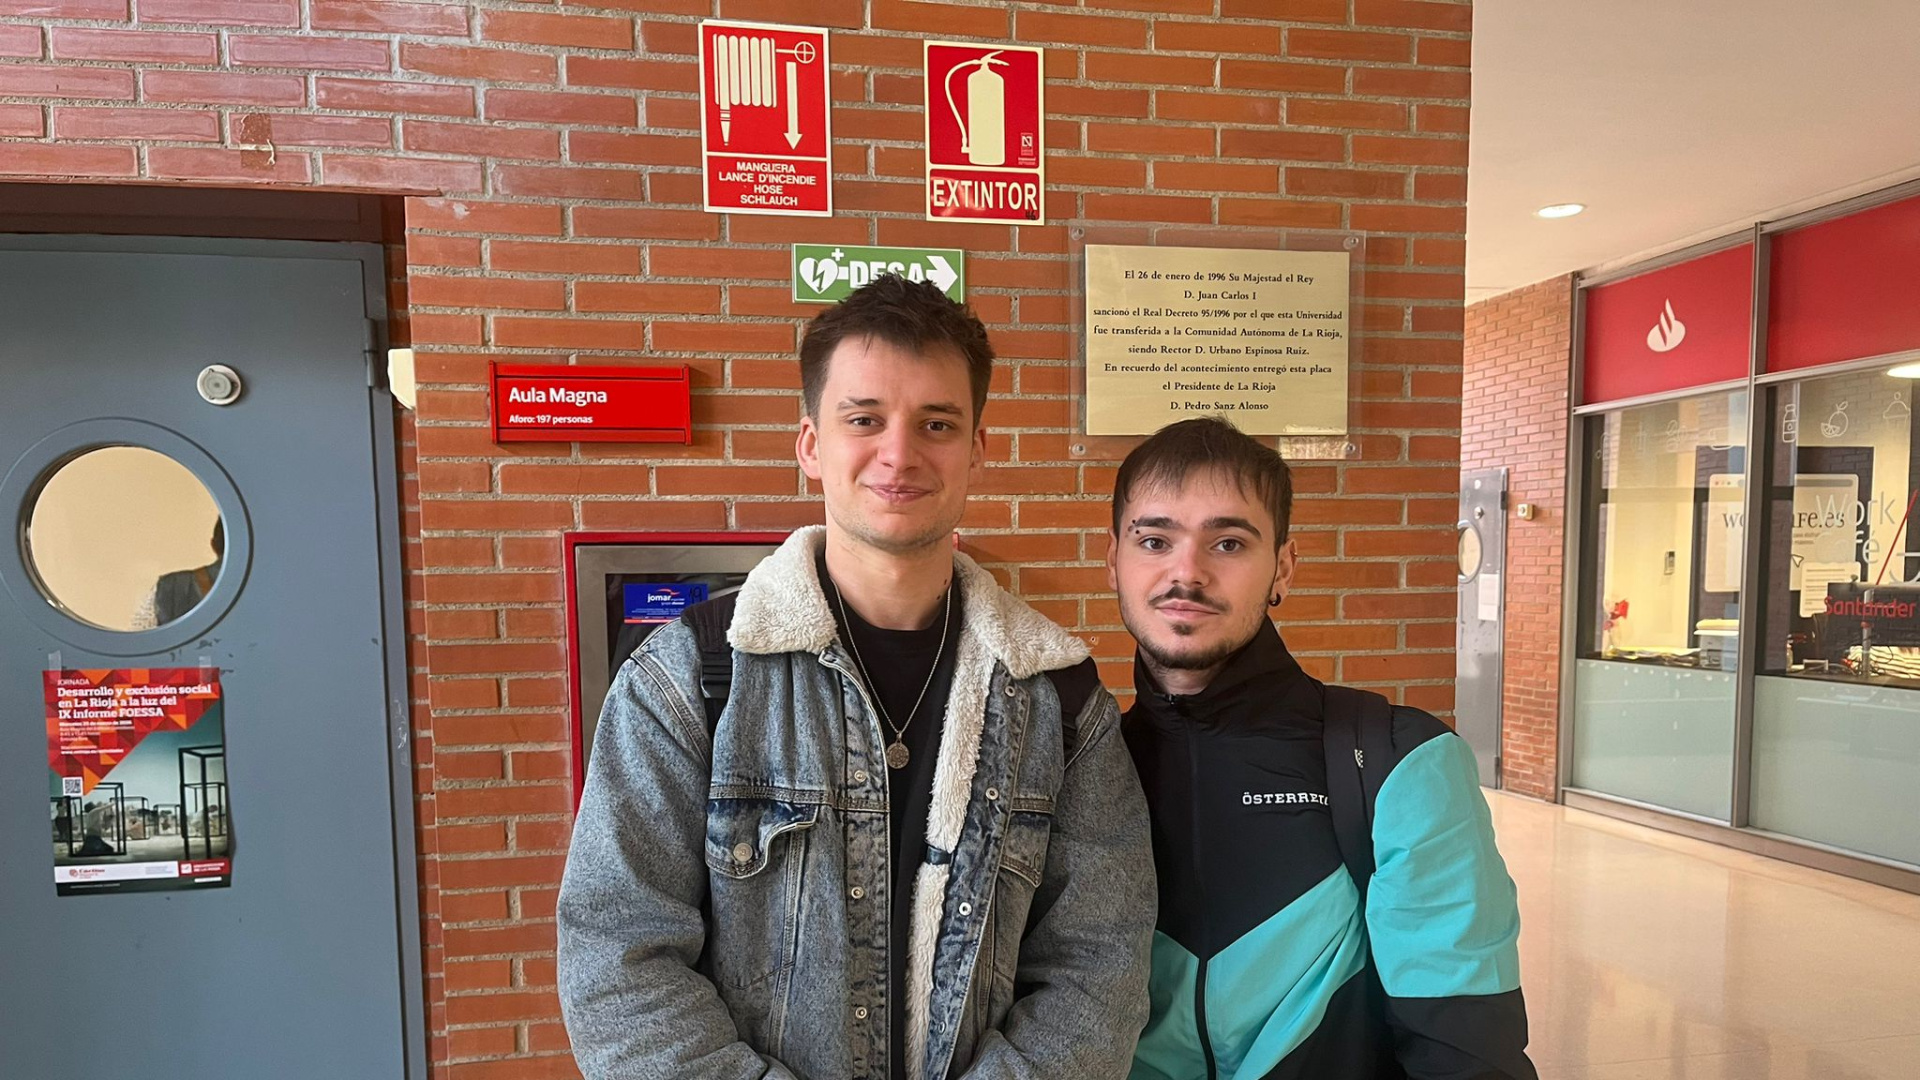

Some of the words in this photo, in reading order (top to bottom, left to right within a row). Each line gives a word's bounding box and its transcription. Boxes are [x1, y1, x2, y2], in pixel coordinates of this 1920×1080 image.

[736, 161, 796, 174] MANGUERA
[719, 172, 754, 182] LANCE
[758, 174, 816, 186] D'INCENDIE
[754, 184, 783, 194] HOSE
[933, 179, 1037, 210] EXTINTOR
[740, 194, 798, 206] SCHLAUCH
[1125, 270, 1135, 279] El
[1138, 271, 1148, 279] 26
[1151, 271, 1161, 280] de
[1194, 272, 1204, 281] de
[1208, 273, 1225, 281] 1996
[1229, 273, 1240, 282] Su
[1243, 274, 1282, 284] Majestad
[1286, 274, 1293, 282] el
[1296, 275, 1314, 285] Rey
[1184, 291, 1195, 299] D.
[1197, 291, 1218, 301] Juan
[1221, 291, 1249, 300] Carlos
[1252, 292, 1256, 300] I
[1093, 308, 1129, 316] sancionó
[1133, 308, 1140, 316] el
[1143, 308, 1162, 317] Real
[1165, 309, 1198, 317] Decreto
[1201, 309, 1230, 318] 95/1996
[1233, 311, 1247, 320] por
[1250, 310, 1258, 319] el
[1261, 312, 1275, 321] que
[1296, 310, 1342, 320] Universidad
[1094, 325, 1108, 335] fue
[1112, 326, 1161, 335] transferida
[1173, 327, 1181, 336] la
[1185, 327, 1237, 336] Comunidad
[1240, 328, 1285, 337] Autónoma
[1289, 328, 1299, 337] de
[1302, 329, 1313, 337] La
[1317, 329, 1343, 340] Rioja,
[1128, 345, 1157, 354] siendo
[1160, 345, 1191, 354] Rector
[1195, 346, 1206, 354] D.
[1209, 346, 1241, 355] Urbano
[1245, 346, 1282, 356] Espinosa
[1286, 347, 1309, 355] Ruiz.
[1121, 363, 1160, 372] recuerdo
[1164, 363, 1177, 372] del
[1181, 364, 1250, 373] acontecimiento
[1253, 365, 1287, 375] entregó
[1310, 364, 1332, 375] placa
[1162, 381, 1170, 390] el
[1174, 382, 1220, 391] Presidente
[1224, 382, 1234, 391] de
[1238, 383, 1249, 391] La
[1252, 382, 1276, 393] Rioja
[509, 387, 546, 403] Aula
[549, 388, 607, 407] Magna
[1170, 402, 1181, 410] D.
[1184, 401, 1211, 410] Pedro
[1214, 402, 1235, 410] Sanz
[1238, 401, 1269, 410] Alonso
[509, 415, 535, 423] Aforo:
[537, 415, 551, 423] 197
[552, 416, 593, 425] personas
[1815, 491, 1896, 527] Work
[648, 594, 671, 602] jomar
[1823, 596, 1916, 619] Santander
[58, 687, 114, 697] Desarrollo
[116, 687, 124, 698] y
[125, 685, 177, 695] exclusión
[179, 684, 211, 694] social
[58, 699, 72, 708] en
[75, 698, 88, 707] La
[90, 697, 118, 709] Rioja
[129, 697, 139, 706] la
[141, 696, 158, 706] luz
[160, 696, 176, 705] del
[58, 710, 71, 719] IX
[73, 708, 117, 718] informe
[119, 707, 164, 717] FOESSA
